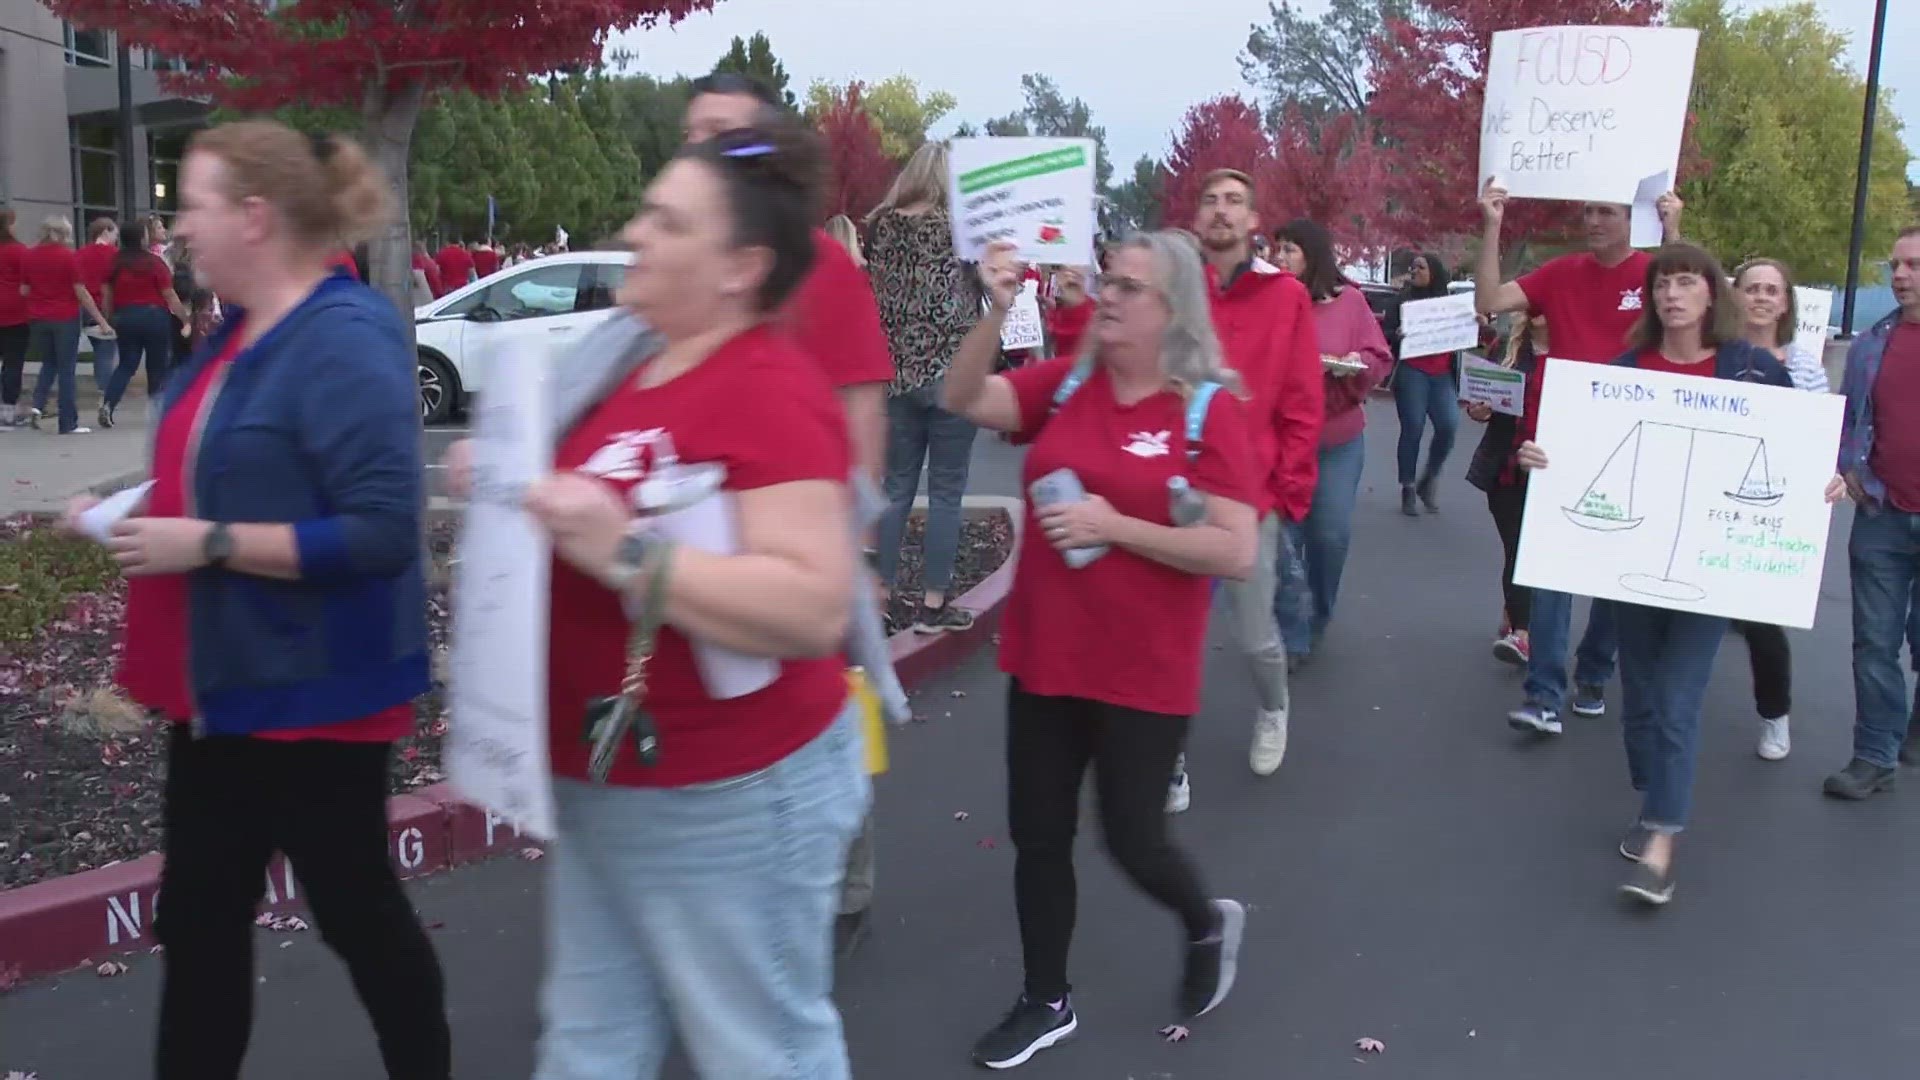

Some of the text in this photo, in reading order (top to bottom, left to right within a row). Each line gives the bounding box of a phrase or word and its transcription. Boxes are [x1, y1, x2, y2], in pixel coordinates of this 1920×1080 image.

[1515, 32, 1632, 86] FCUSD
[1484, 97, 1617, 134] We Deserve
[1674, 388, 1750, 417] THINKING
[1708, 509, 1741, 521] FCEA
[1726, 527, 1766, 548] Fund
[1697, 549, 1729, 569] Fund
